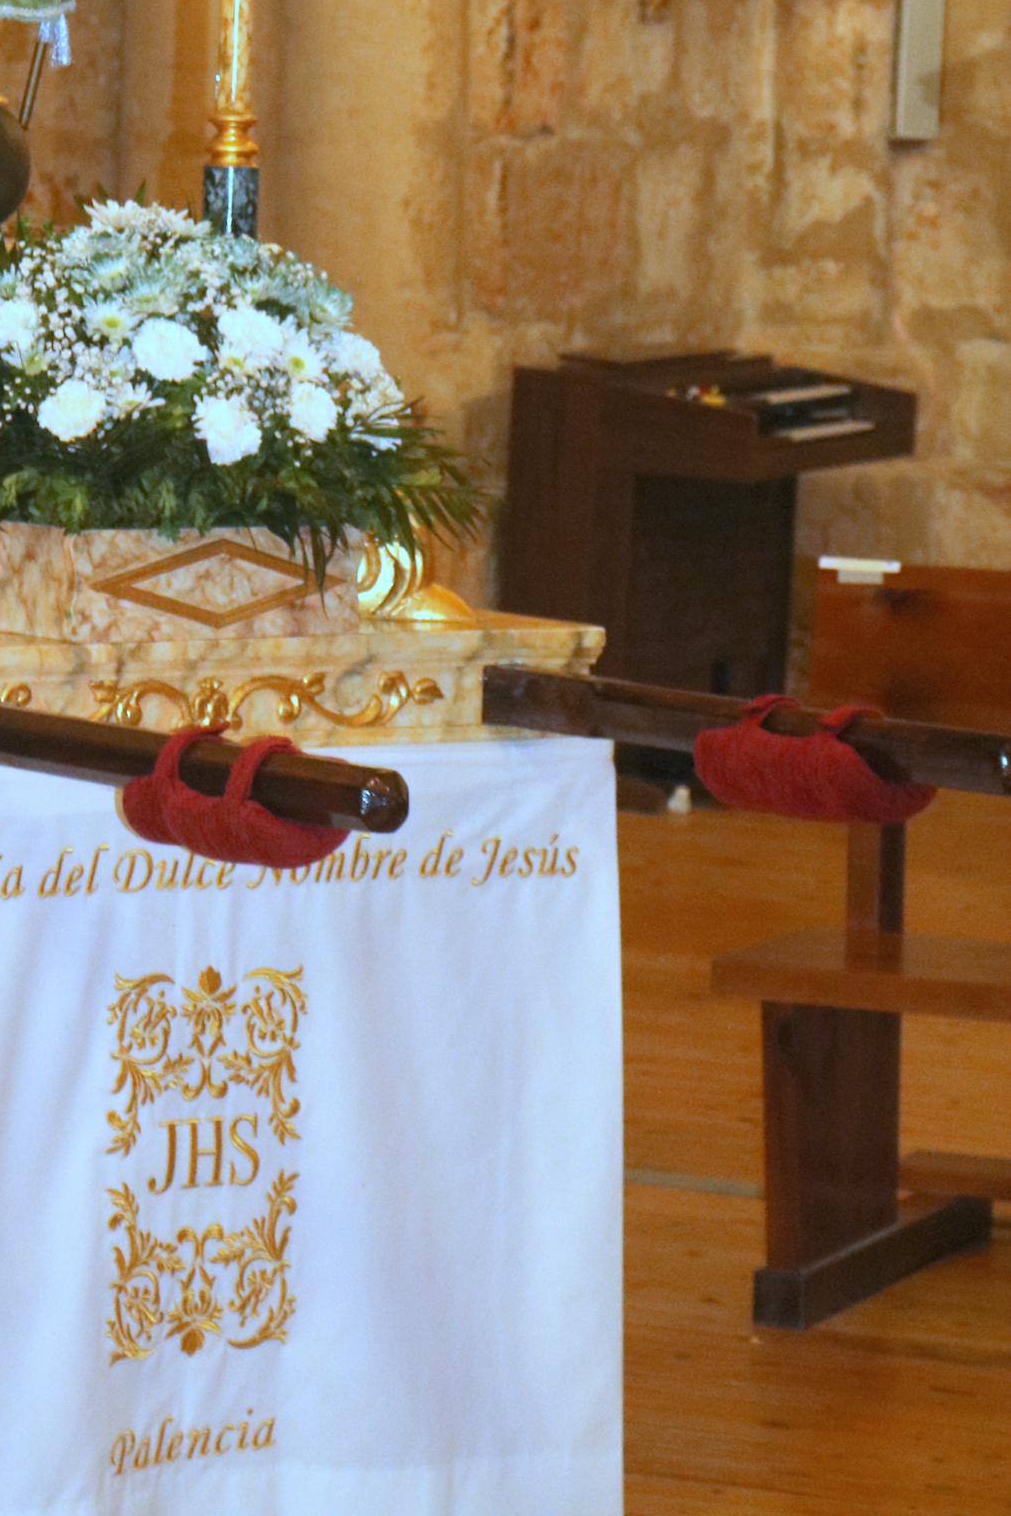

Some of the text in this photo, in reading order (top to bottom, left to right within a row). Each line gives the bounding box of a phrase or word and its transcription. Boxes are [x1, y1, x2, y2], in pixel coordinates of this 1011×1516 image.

[37, 843, 109, 898] del
[113, 846, 237, 893] Dulce
[418, 829, 464, 878] de
[470, 834, 579, 887] Jesús
[146, 1113, 261, 1195] JHS
[109, 1407, 276, 1476] Palencia
